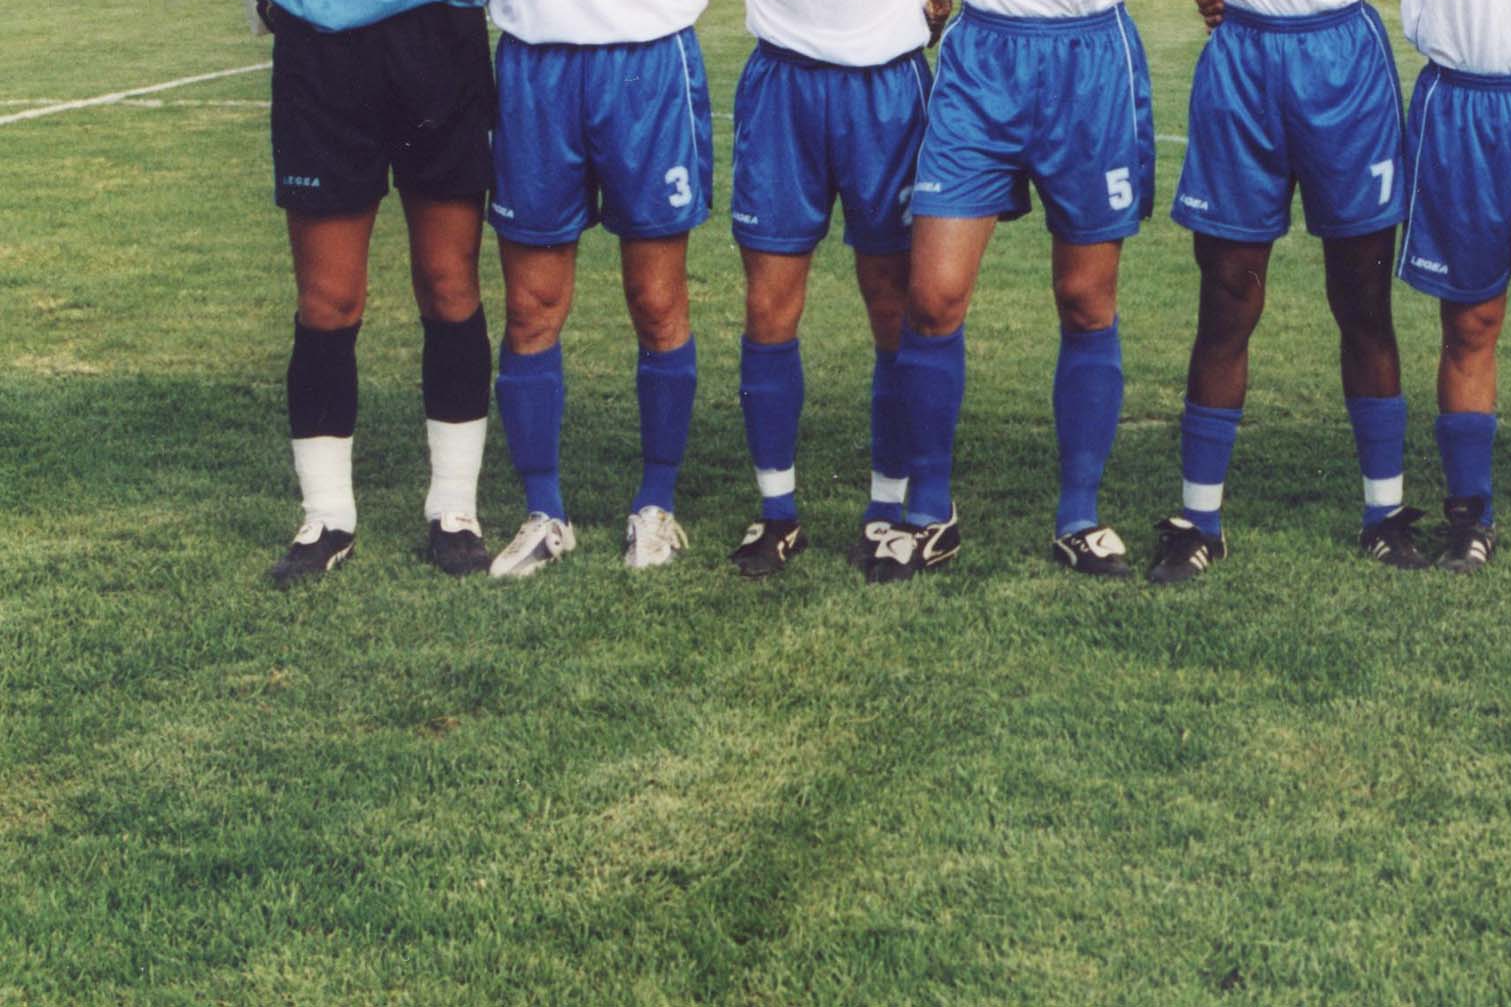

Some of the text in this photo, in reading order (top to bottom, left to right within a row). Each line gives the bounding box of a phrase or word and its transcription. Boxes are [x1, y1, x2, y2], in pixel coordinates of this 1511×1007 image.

[665, 166, 693, 208] 3
[1105, 166, 1133, 211] 5
[1370, 158, 1395, 206] 7
[1411, 255, 1449, 275] LEGEA
